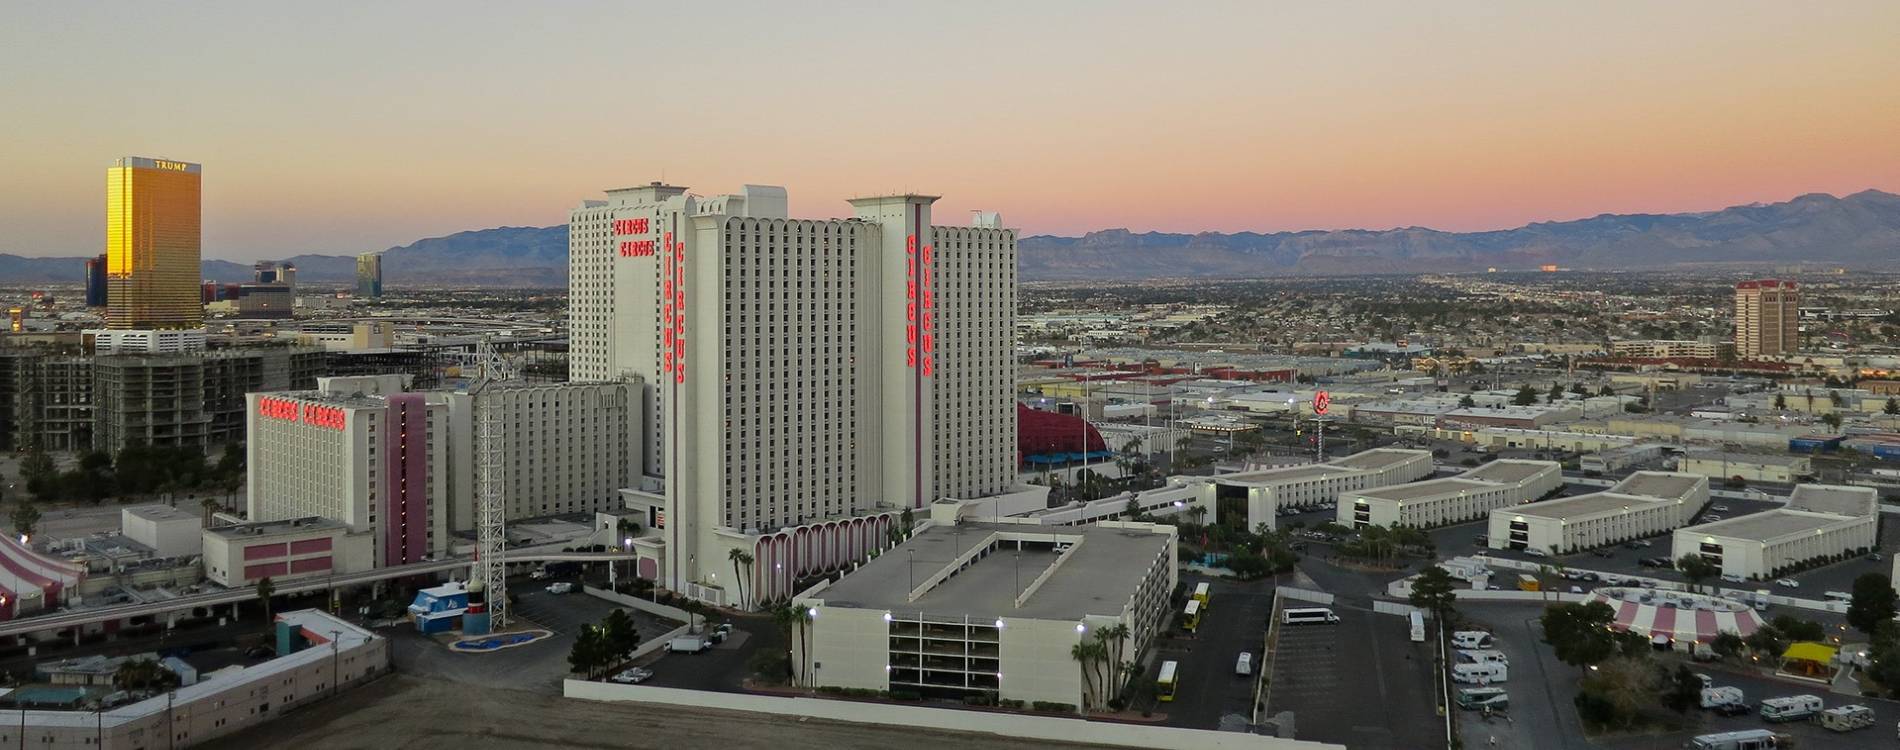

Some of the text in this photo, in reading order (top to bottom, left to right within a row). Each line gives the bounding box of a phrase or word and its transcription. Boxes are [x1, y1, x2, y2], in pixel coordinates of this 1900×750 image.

[155, 161, 187, 171] TRUMP
[614, 218, 649, 236] CIRCUS
[620, 240, 654, 256] CIRCUS
[664, 231, 672, 373] CIRCUS
[676, 241, 685, 384] CIRCUS
[907, 234, 917, 368] CIRCUS
[923, 244, 933, 377] CIRCUS
[260, 396, 345, 431] CIRCUS CIRCUS
